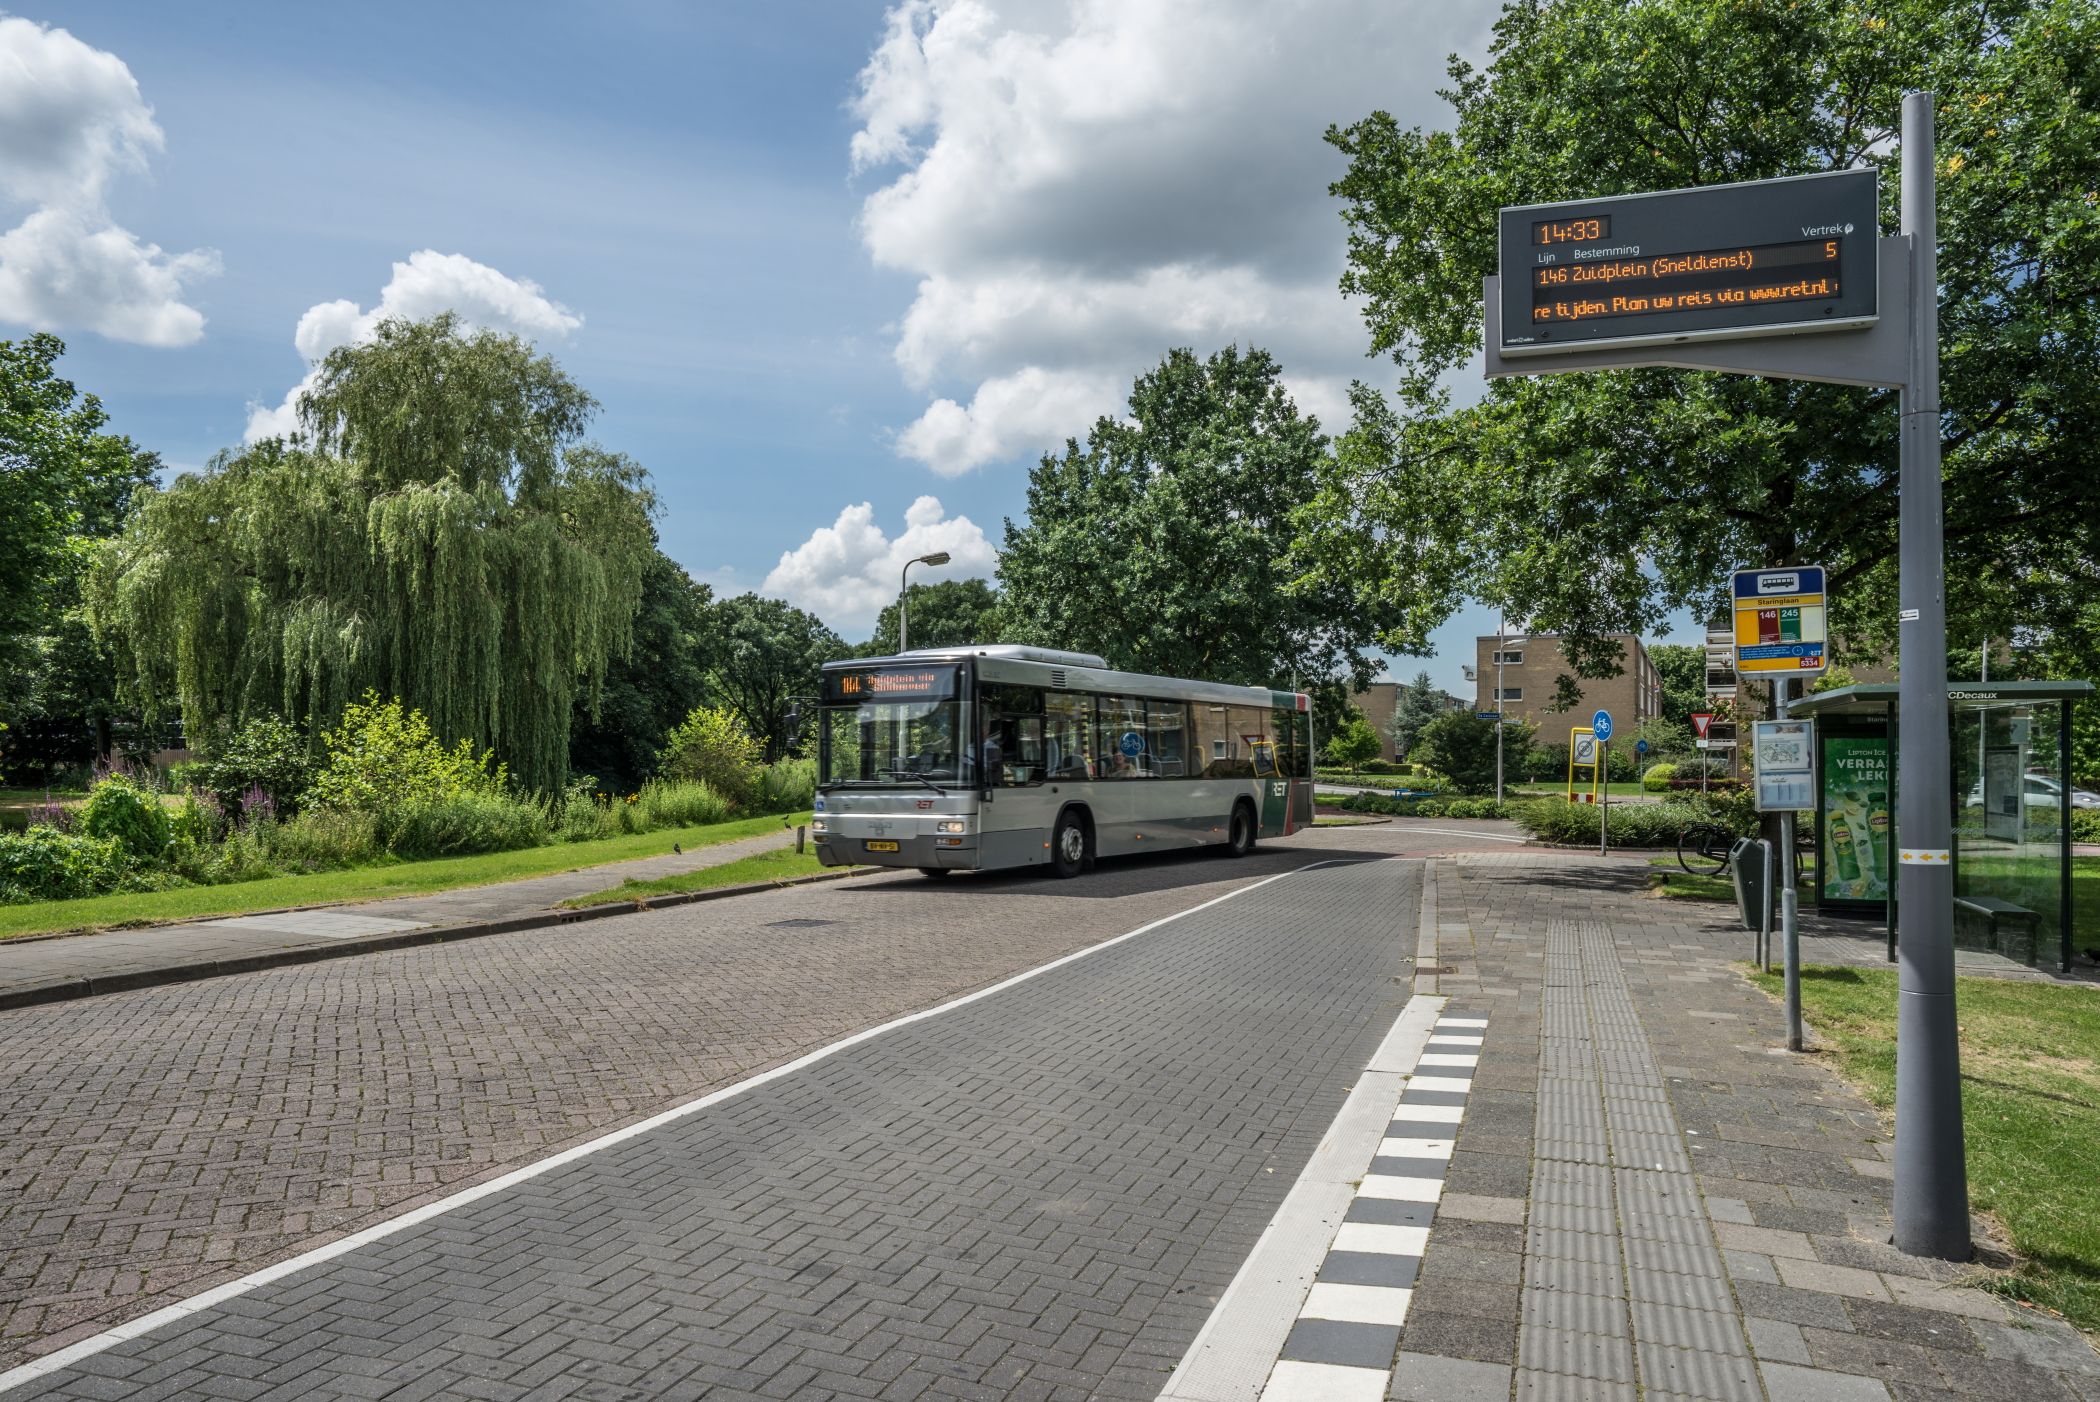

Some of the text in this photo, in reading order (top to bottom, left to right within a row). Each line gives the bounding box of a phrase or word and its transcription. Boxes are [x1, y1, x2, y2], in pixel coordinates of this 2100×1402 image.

[1541, 220, 1599, 244] 14:33
[1801, 223, 1843, 237] Vertrek
[1538, 244, 1640, 264] Lijn Bestemming
[1540, 242, 1837, 284] 146 Zuidplein (Sneldienst) 5
[1612, 296, 1648, 312] Plan
[1653, 296, 1673, 309] uw
[1678, 291, 1713, 306] reis
[1717, 289, 1745, 303] via
[1757, 597, 1800, 606] Staringlaan
[1760, 610, 1776, 619] 146
[1781, 609, 1799, 618] 245
[1947, 691, 1998, 700] CDecaux
